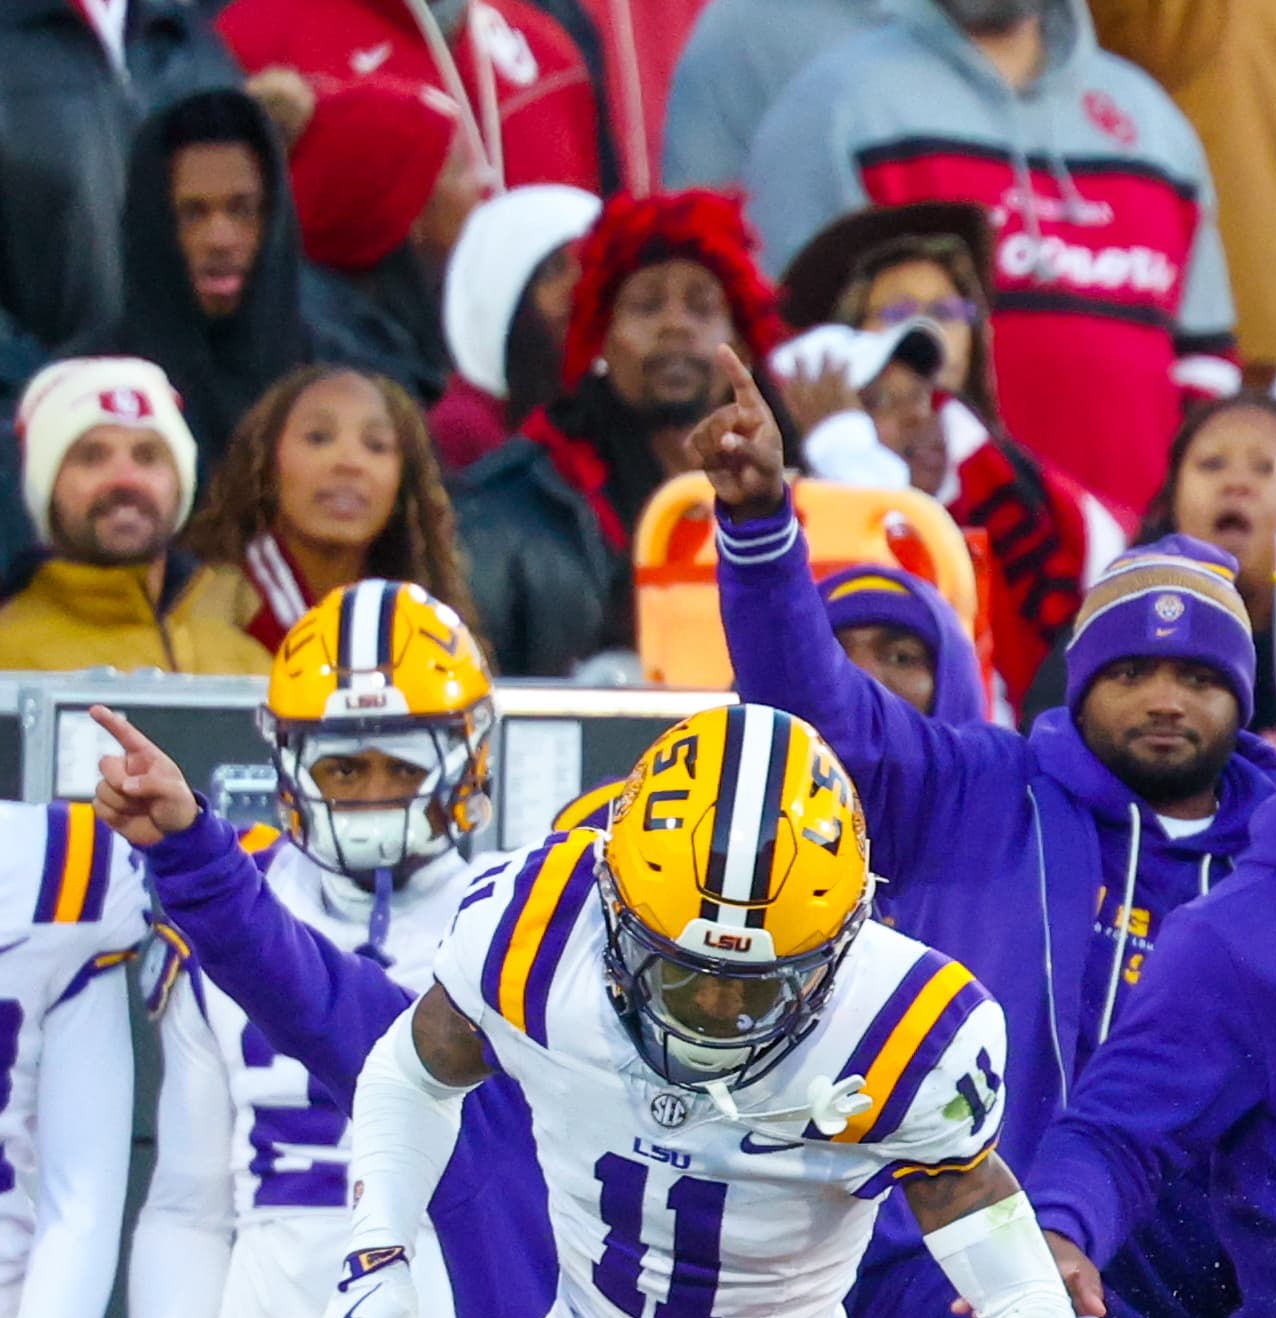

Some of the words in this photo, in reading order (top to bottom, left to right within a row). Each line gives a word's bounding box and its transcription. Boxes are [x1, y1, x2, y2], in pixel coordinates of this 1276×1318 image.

[643, 734, 699, 832] SU
[801, 754, 847, 857] LS
[703, 930, 752, 951] LSU
[651, 1094, 687, 1128] SEC
[632, 1136, 691, 1170] LSU
